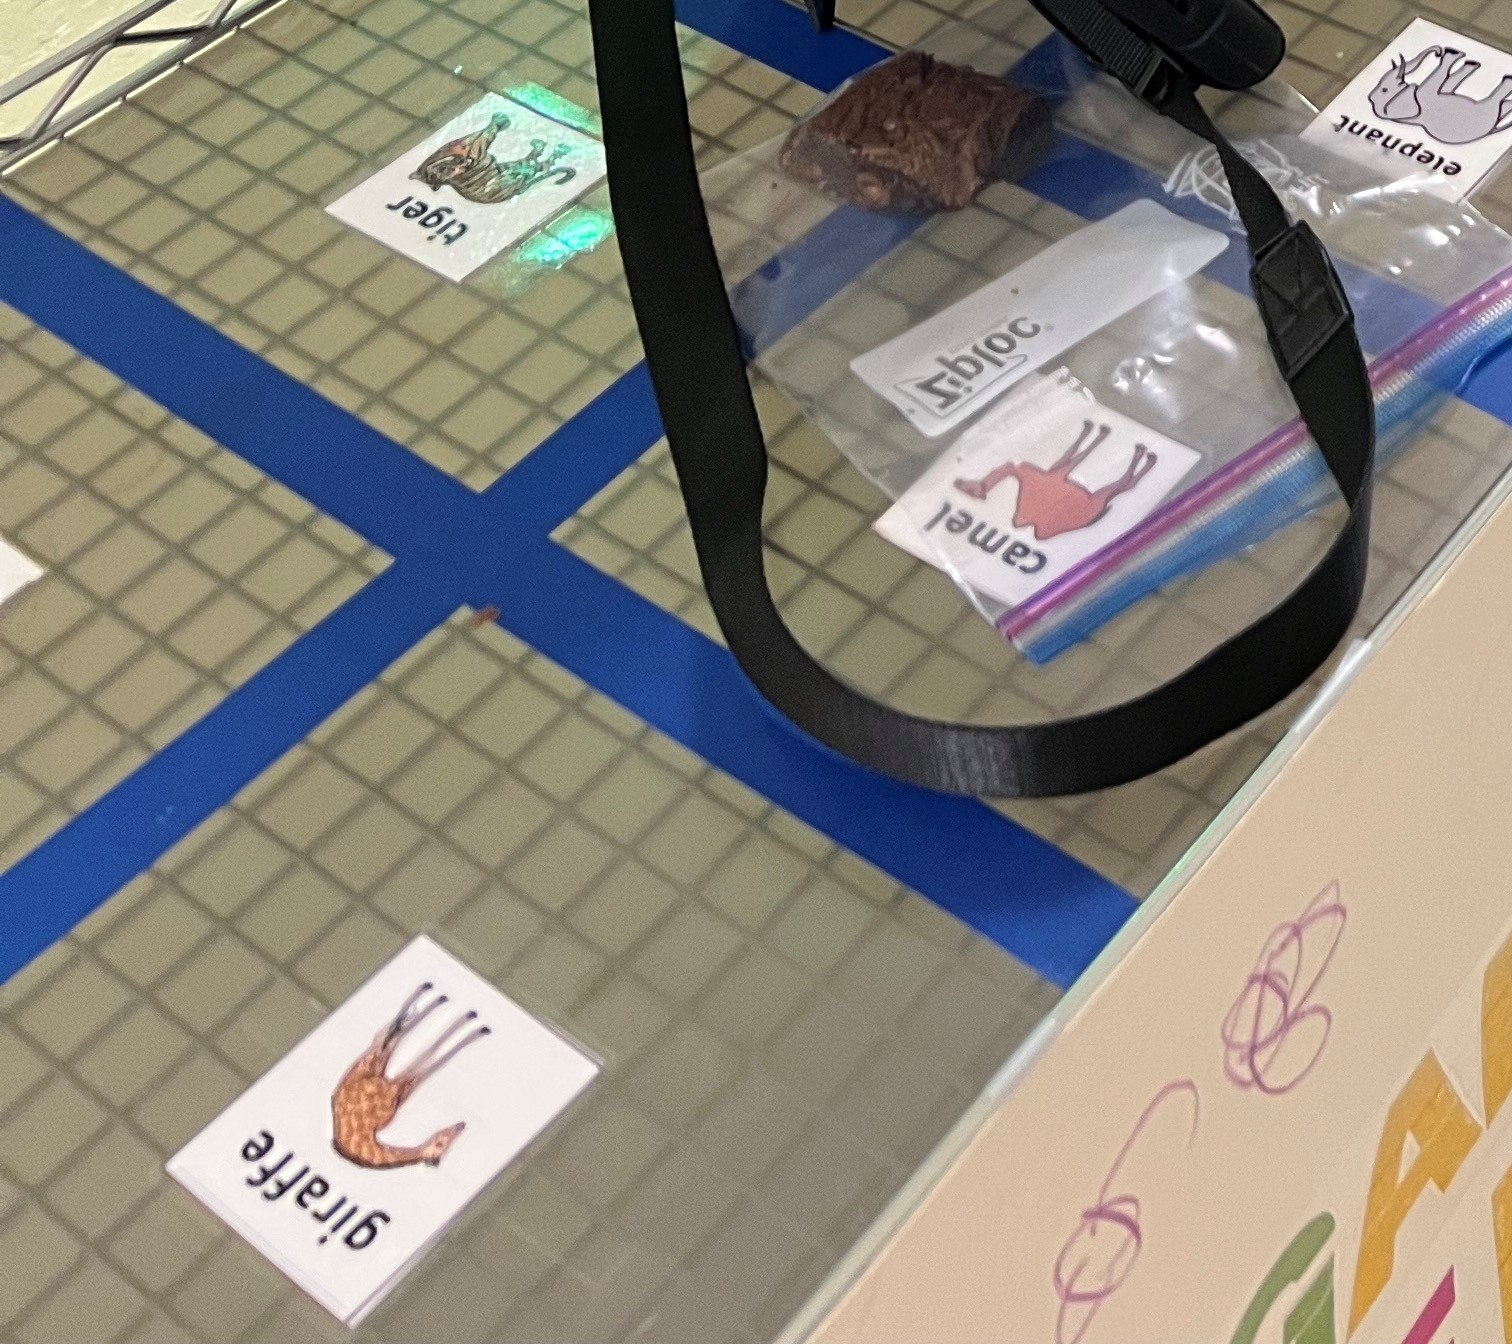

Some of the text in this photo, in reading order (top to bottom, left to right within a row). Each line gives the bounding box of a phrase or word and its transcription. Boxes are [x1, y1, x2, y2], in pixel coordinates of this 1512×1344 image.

[1331, 113, 1463, 177] elephant
[384, 195, 468, 247] tiger
[914, 315, 1042, 411] Ziploc
[923, 499, 1048, 575] camel
[241, 1130, 392, 1251] giraffe
